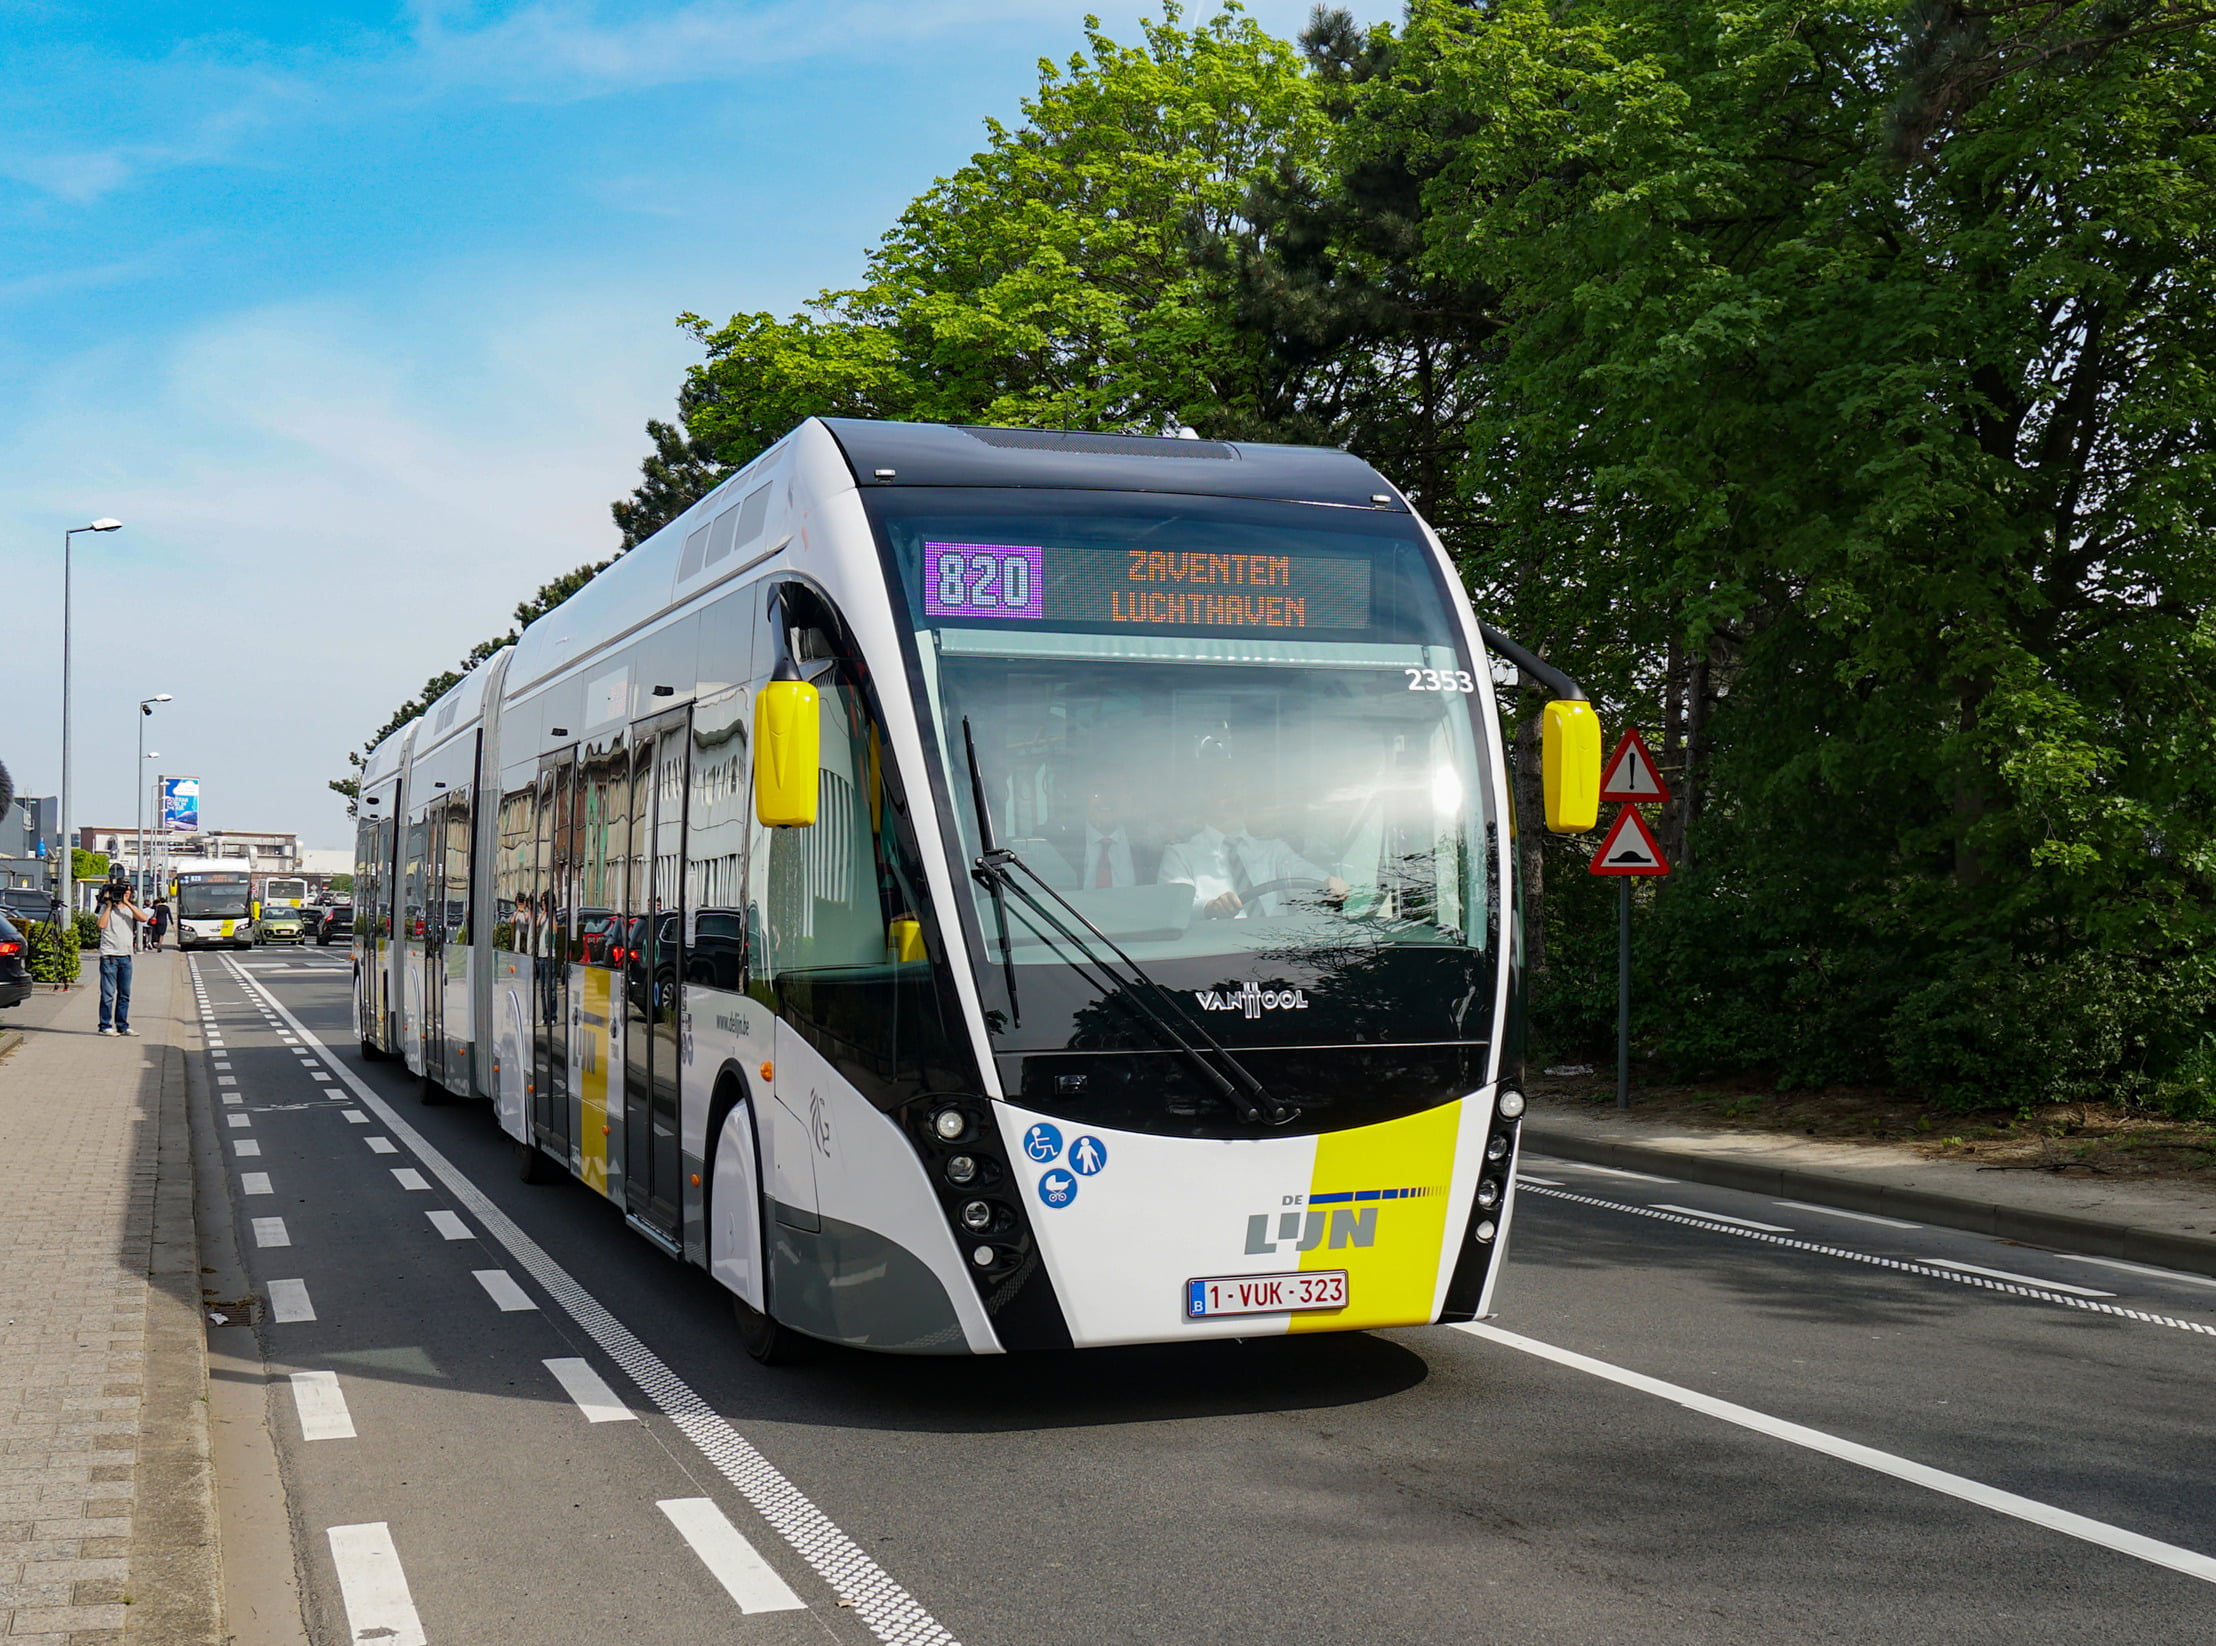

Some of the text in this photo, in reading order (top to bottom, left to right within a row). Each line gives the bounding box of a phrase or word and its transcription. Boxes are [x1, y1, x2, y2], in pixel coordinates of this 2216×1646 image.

[938, 554, 1029, 608] 820
[1129, 550, 1290, 586] ZAVENTEM
[1112, 591, 1305, 627] LUCHTHAVEN
[1405, 668, 1474, 694] 2353
[1282, 1195, 1303, 1206] DE
[1244, 1207, 1378, 1255] LIJN
[1194, 1300, 1203, 1313] B
